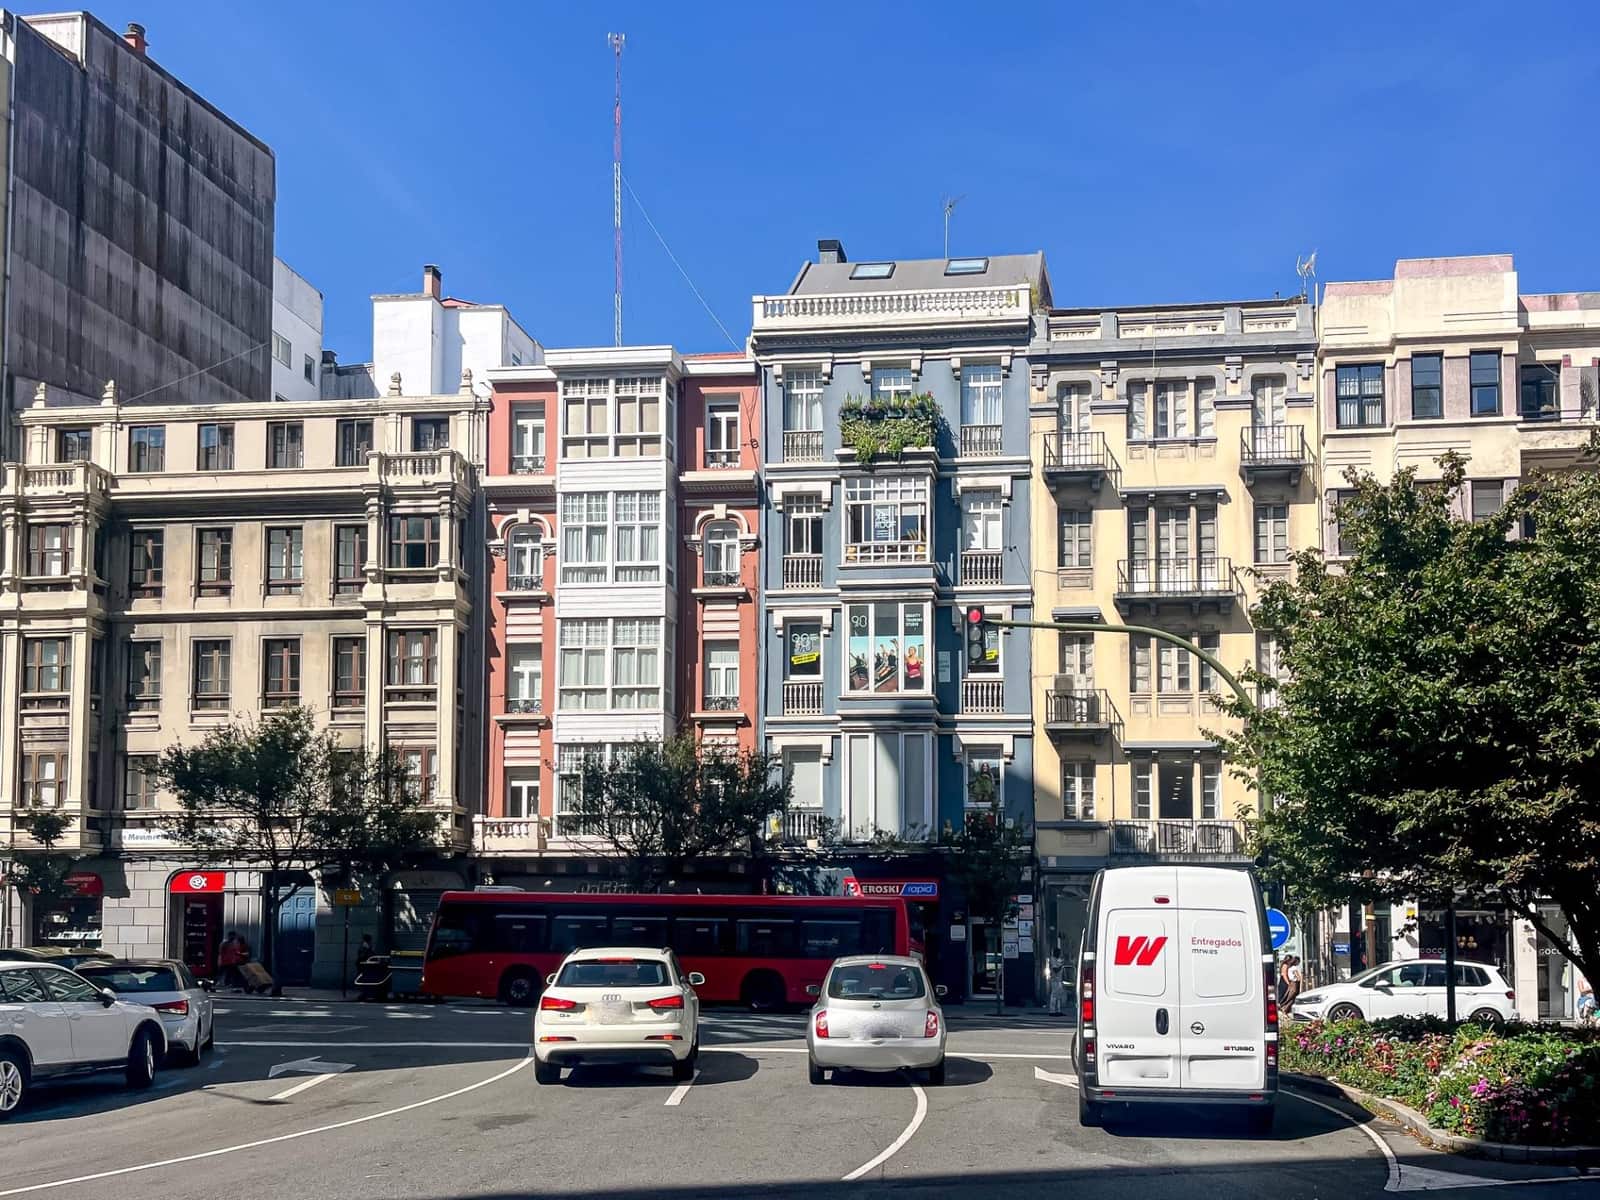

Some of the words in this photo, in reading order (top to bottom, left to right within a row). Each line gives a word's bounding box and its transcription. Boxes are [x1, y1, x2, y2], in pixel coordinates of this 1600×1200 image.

[862, 885, 900, 894] EROSKI
[907, 884, 933, 894] rapid
[1191, 936, 1242, 948] Entregados
